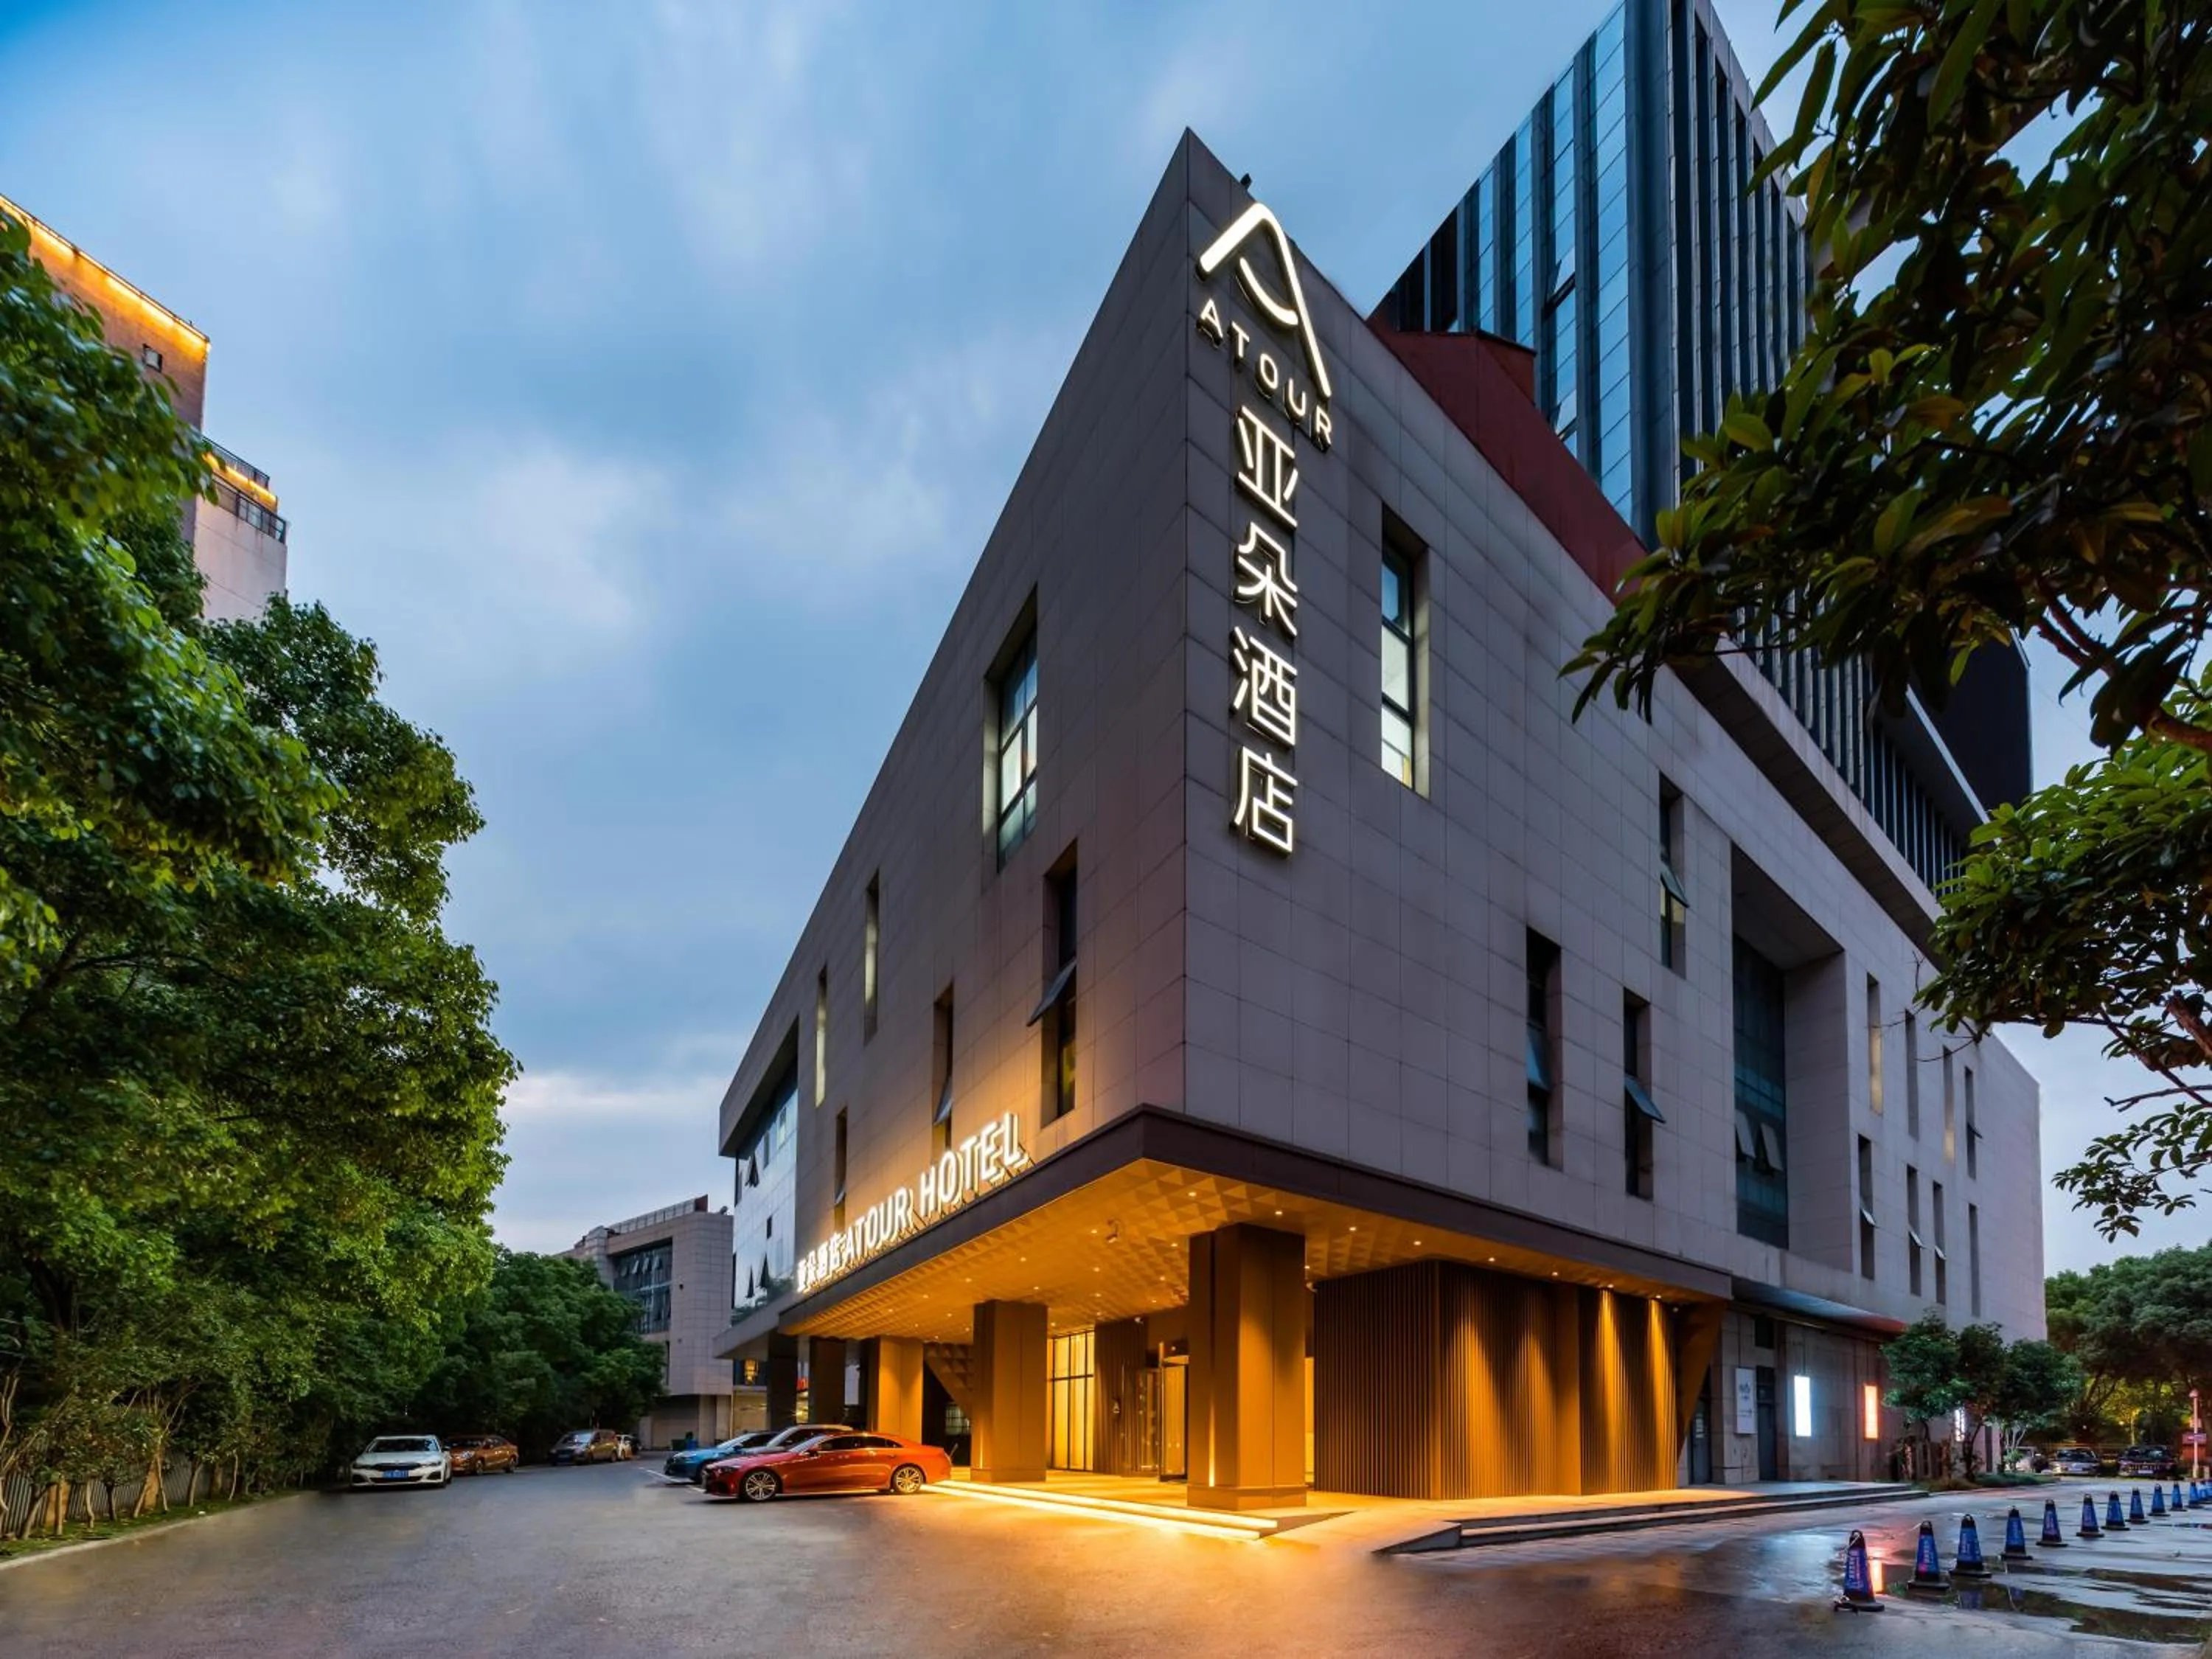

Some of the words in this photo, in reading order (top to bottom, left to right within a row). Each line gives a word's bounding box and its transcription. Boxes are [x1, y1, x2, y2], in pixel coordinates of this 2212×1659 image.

[1200, 299, 1332, 443] ATOUR
[1233, 405, 1298, 852] 亚朵酒店
[846, 1186, 910, 1259] ATOUR
[919, 1111, 1022, 1217] HOTEL
